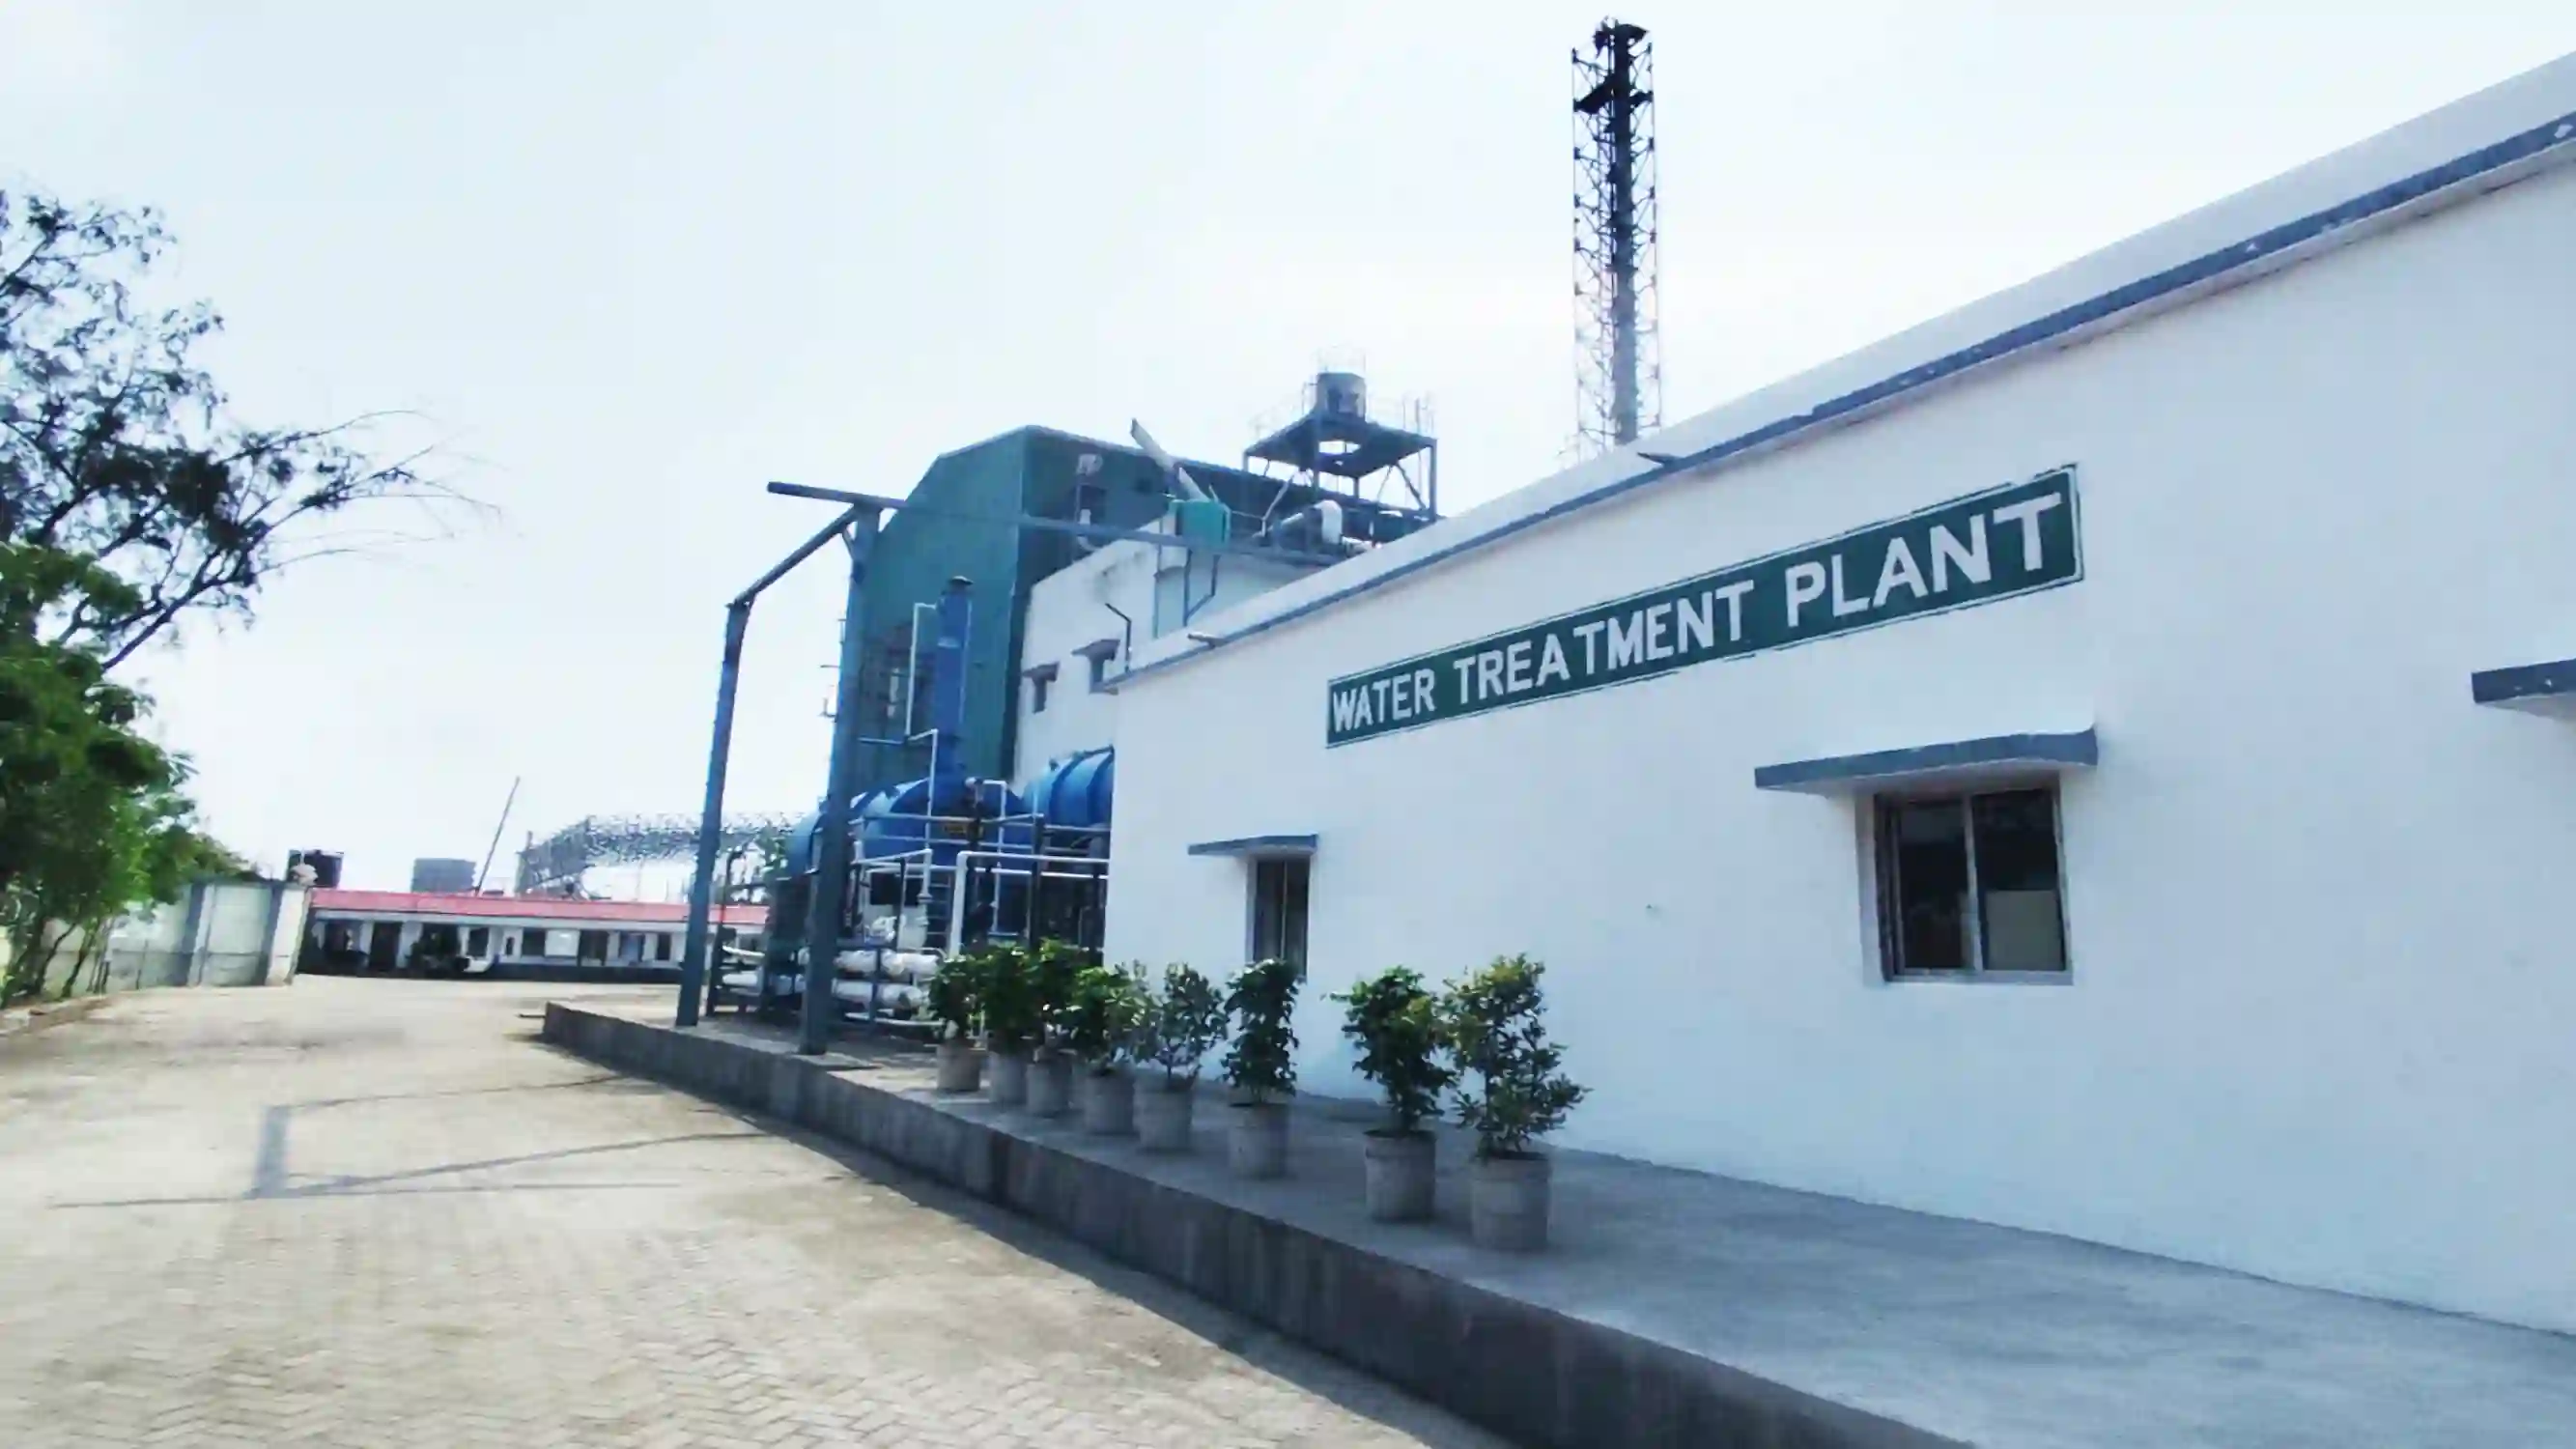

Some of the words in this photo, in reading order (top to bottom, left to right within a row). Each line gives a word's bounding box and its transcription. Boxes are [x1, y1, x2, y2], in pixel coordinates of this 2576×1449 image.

[1331, 668, 1436, 732] WATER
[1454, 579, 1754, 705] TREATMENT
[1785, 492, 2063, 629] PLANT
